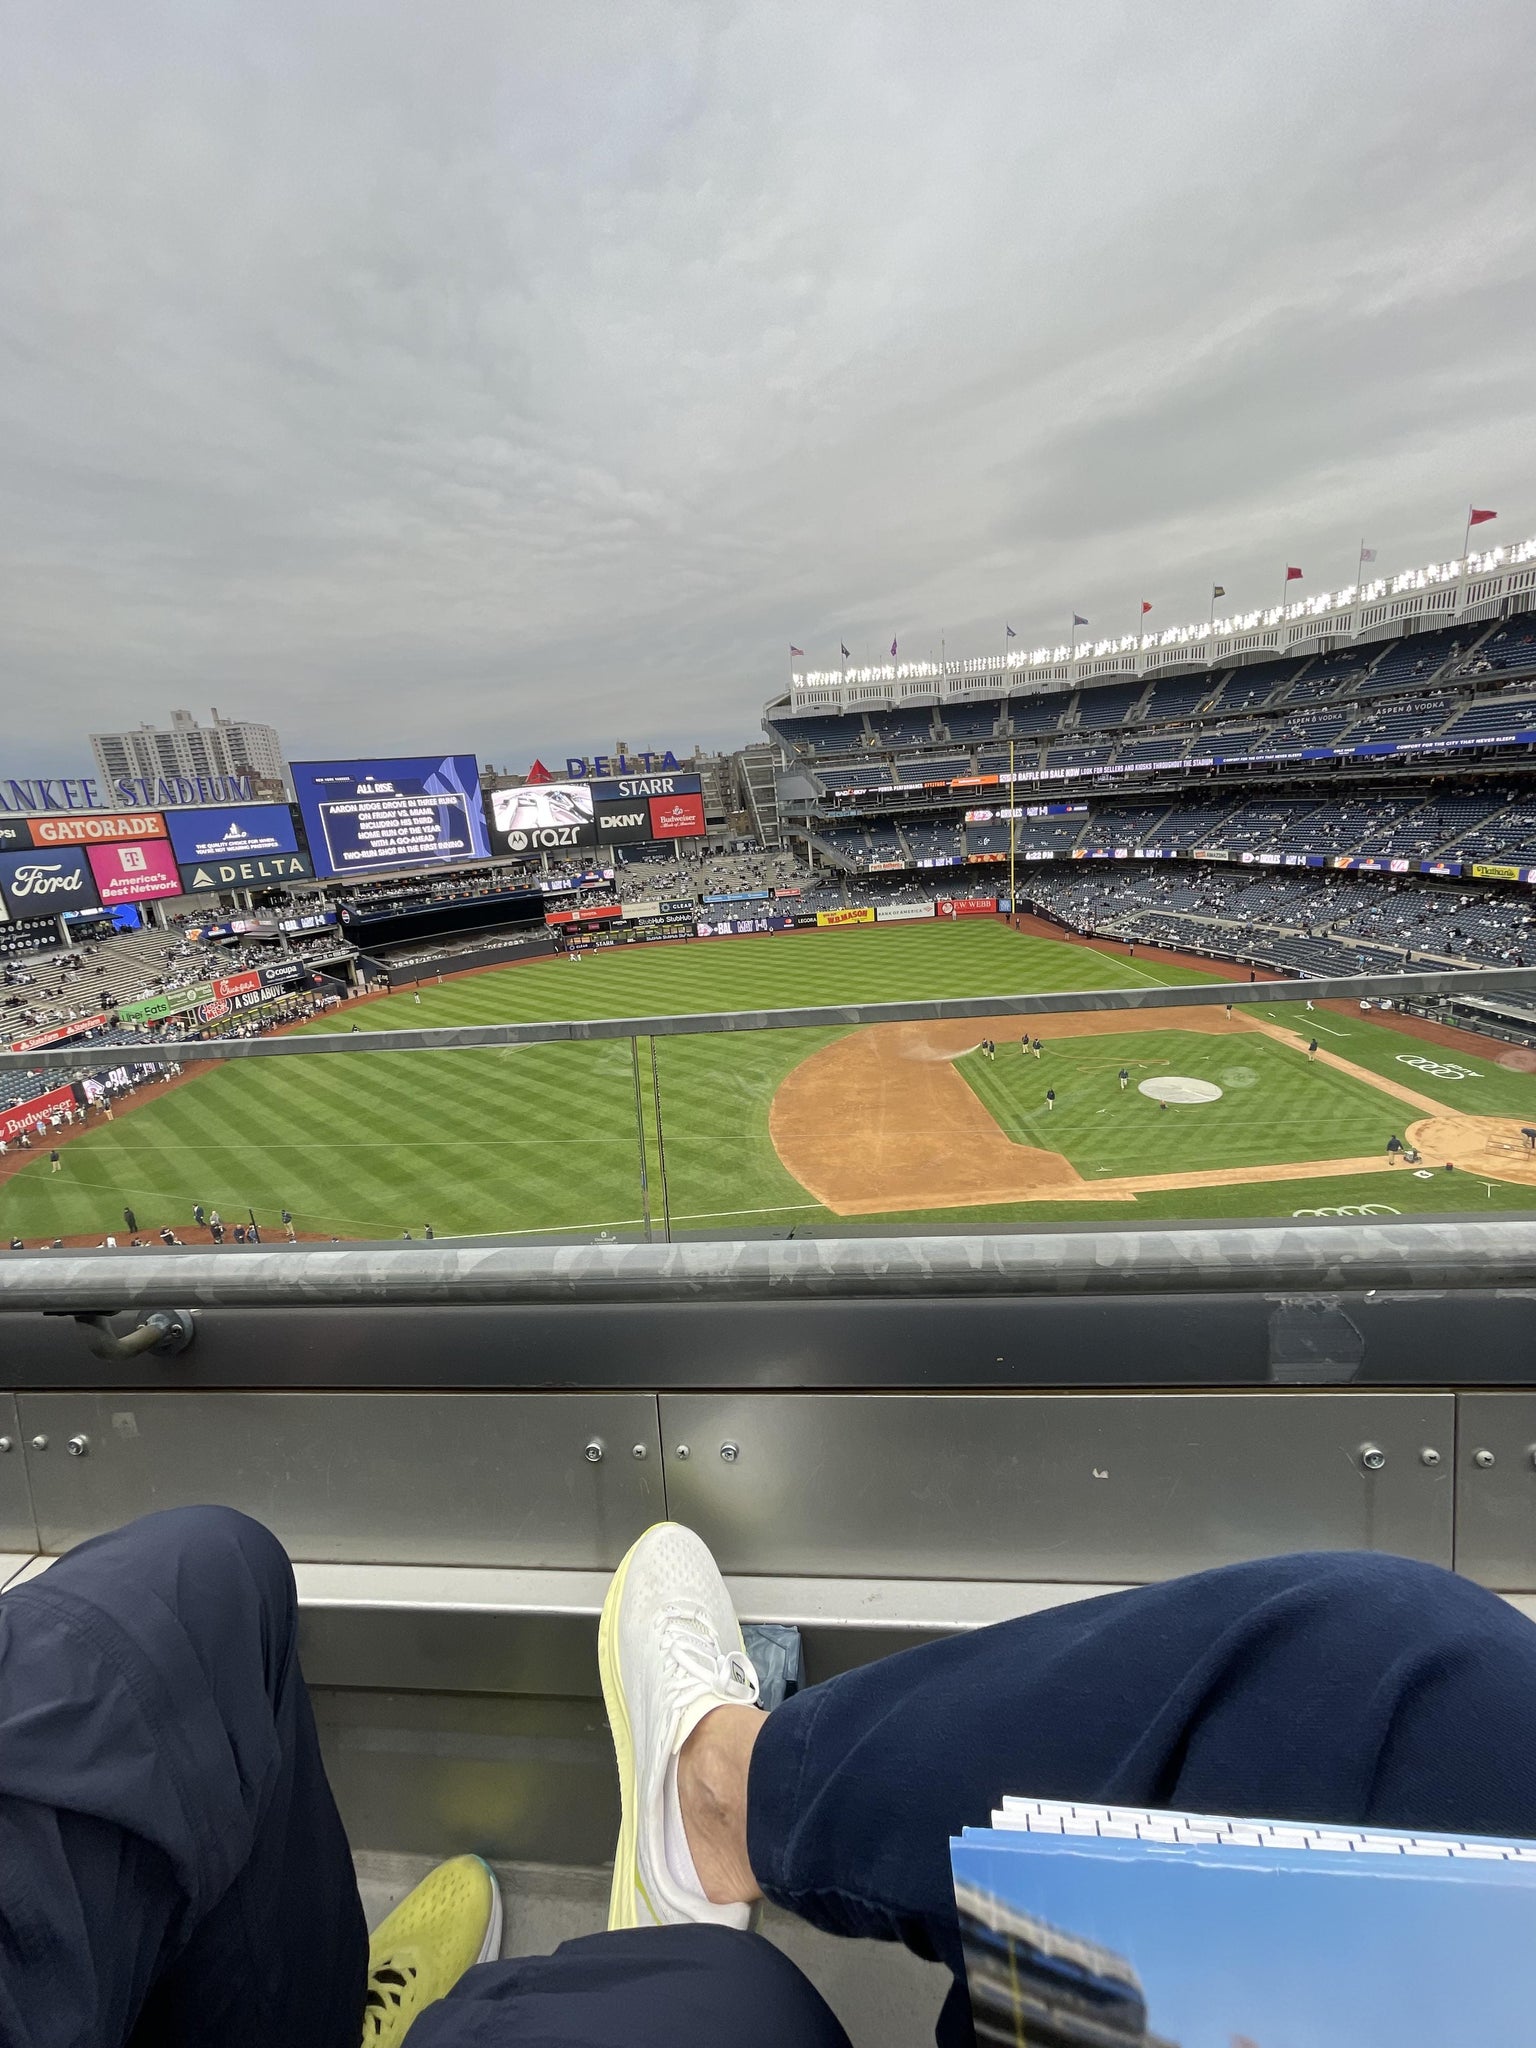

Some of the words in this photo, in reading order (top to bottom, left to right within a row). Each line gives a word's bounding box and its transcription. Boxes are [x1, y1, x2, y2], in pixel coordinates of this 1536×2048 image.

[1376, 706, 1404, 716] ASPEN
[1415, 701, 1445, 710] VODKA
[1318, 713, 1342, 721] VODKA
[566, 750, 682, 779] DELTA
[1094, 766, 1103, 774] FOR
[1104, 765, 1124, 774] SELLERS
[1124, 764, 1134, 772] AND
[1135, 762, 1152, 770] KIOSKS
[1153, 760, 1182, 770] THROUGHOUT
[1192, 758, 1214, 766] STADIUM
[1018, 772, 1040, 782] RAFFLE
[1040, 770, 1049, 780] ON
[1050, 769, 1064, 778] SALE
[1065, 768, 1080, 777] NOW
[114, 776, 253, 807] STADIUM
[356, 784, 374, 794] ALL
[374, 782, 394, 792] RISE
[618, 778, 674, 797] STARR
[330, 804, 358, 814] AARON
[358, 802, 382, 812] JUDGE
[382, 800, 407, 810] DROVE
[408, 799, 416, 808] IN
[416, 798, 438, 806] THREE
[438, 796, 458, 805] RUNS
[358, 812, 372, 820] ON
[372, 810, 398, 819] FRIDAY
[600, 813, 646, 829] DKNY
[660, 815, 696, 824] Budweiser
[40, 817, 160, 841] GATORADE
[360, 819, 400, 830] INCLUDING
[400, 818, 412, 826] HIS
[413, 816, 433, 825] THIRD
[358, 830, 380, 840] HOME
[382, 828, 397, 838] RUN
[398, 828, 409, 836] OF
[409, 826, 422, 834] THE
[422, 824, 442, 833] YEAR
[532, 826, 580, 848] razr
[370, 839, 388, 848] WITH
[390, 838, 396, 846] A
[396, 834, 435, 844] GO-AHEAD
[343, 850, 378, 860] TWO-RUN
[378, 848, 396, 856] SHOT
[398, 846, 406, 854] IN
[407, 844, 420, 853] THE
[420, 842, 438, 852] FIRST
[438, 840, 464, 850] INNING
[1026, 852, 1042, 860] 6:22
[1042, 852, 1054, 860] PM
[219, 858, 304, 882] DELTA
[11, 864, 82, 896] Ford
[110, 873, 166, 888] America's
[102, 887, 128, 898] Best
[129, 880, 178, 895] Network
[672, 902, 692, 910] CLEAR
[968, 900, 992, 908] WEBB
[638, 917, 664, 926] StubHub
[666, 914, 692, 923] StubHub
[718, 922, 732, 934] BAL
[276, 966, 297, 975] coupa
[235, 996, 242, 1009] A
[242, 994, 260, 1007] SUB
[260, 985, 286, 1001] ABOVE
[144, 1003, 167, 1015] Eats
[6, 1098, 72, 1135] Budweiser
